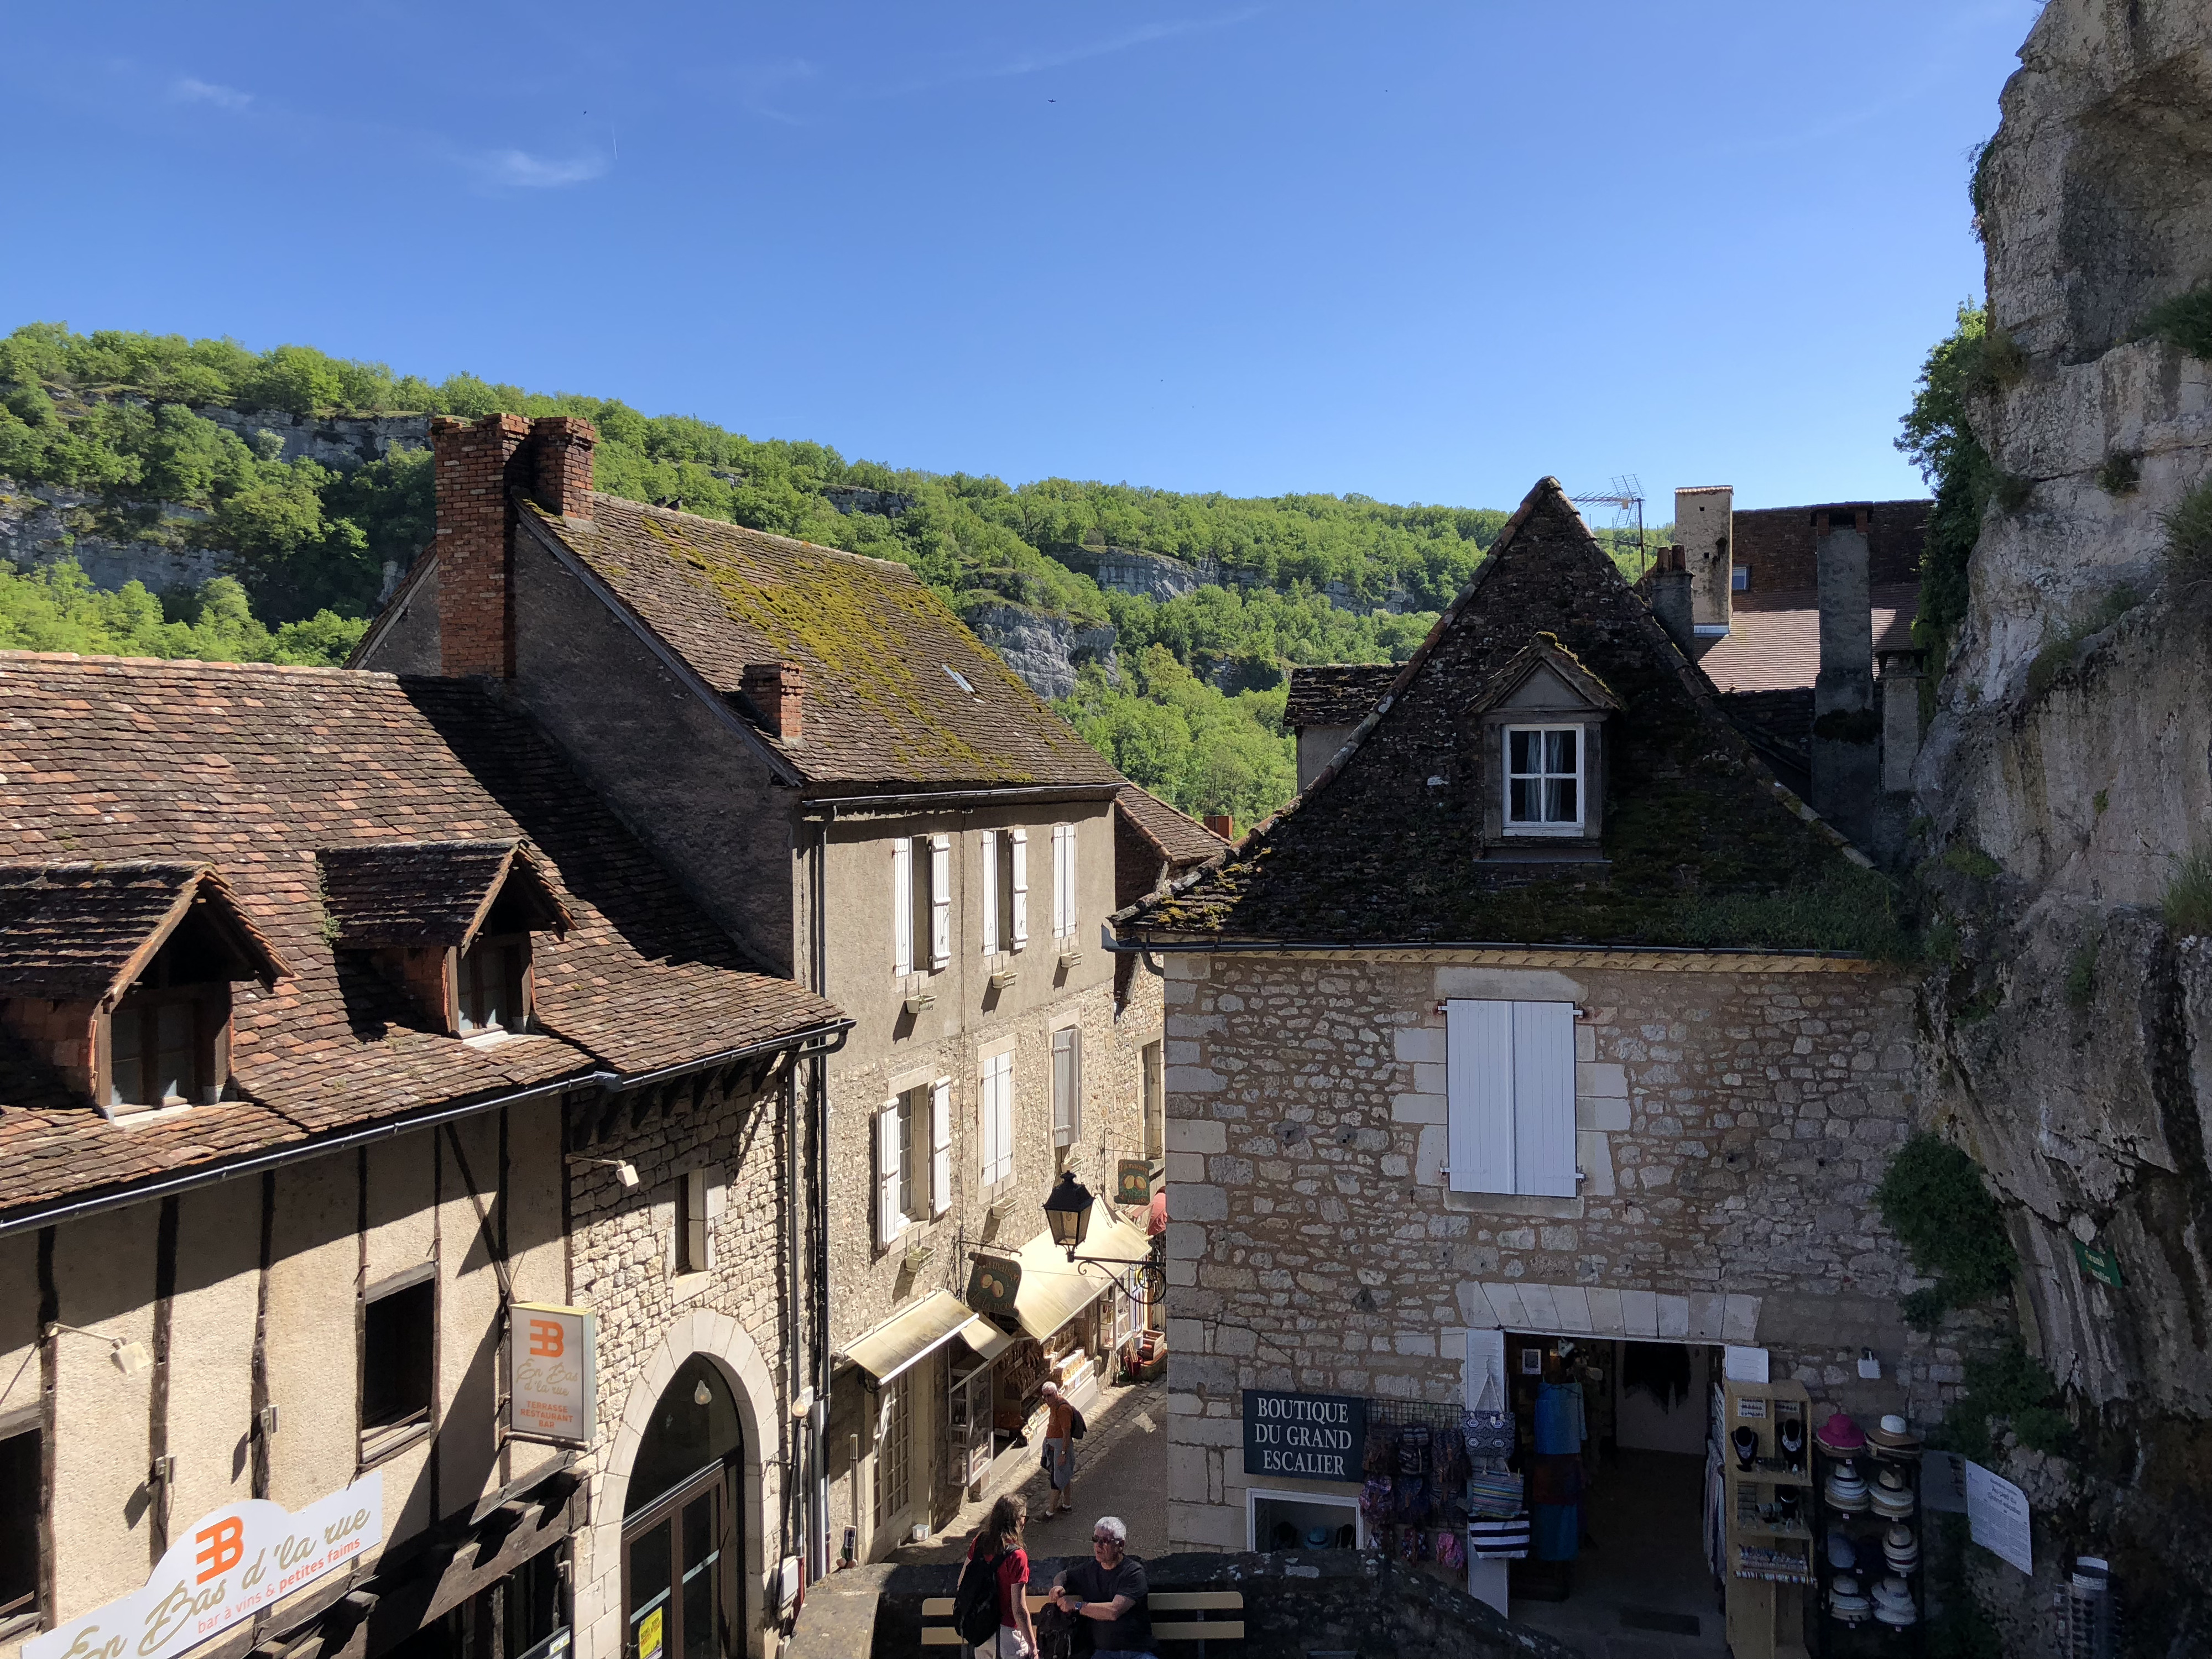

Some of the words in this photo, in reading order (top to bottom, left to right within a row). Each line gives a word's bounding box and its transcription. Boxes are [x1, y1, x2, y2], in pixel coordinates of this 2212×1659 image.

[982, 1296, 990, 1311] la
[517, 1358, 544, 1383] En
[546, 1361, 579, 1384] Bas
[553, 1386, 570, 1396] rue
[520, 1408, 573, 1422] RESTAURANT
[526, 1401, 568, 1413] TERRASSE
[1257, 1397, 1349, 1425] BOUTIQUE
[539, 1419, 555, 1428] BAR
[1255, 1423, 1281, 1444] DU
[1286, 1426, 1352, 1449] GRAND
[1262, 1449, 1345, 1476] ESCALIER
[138, 1578, 227, 1656] Bas
[324, 1508, 371, 1545] rue
[198, 1614, 220, 1634] bar
[224, 1606, 231, 1620] à
[236, 1593, 262, 1613] vins
[265, 1583, 276, 1598] &
[279, 1558, 324, 1594] petites
[327, 1538, 361, 1564] faims
